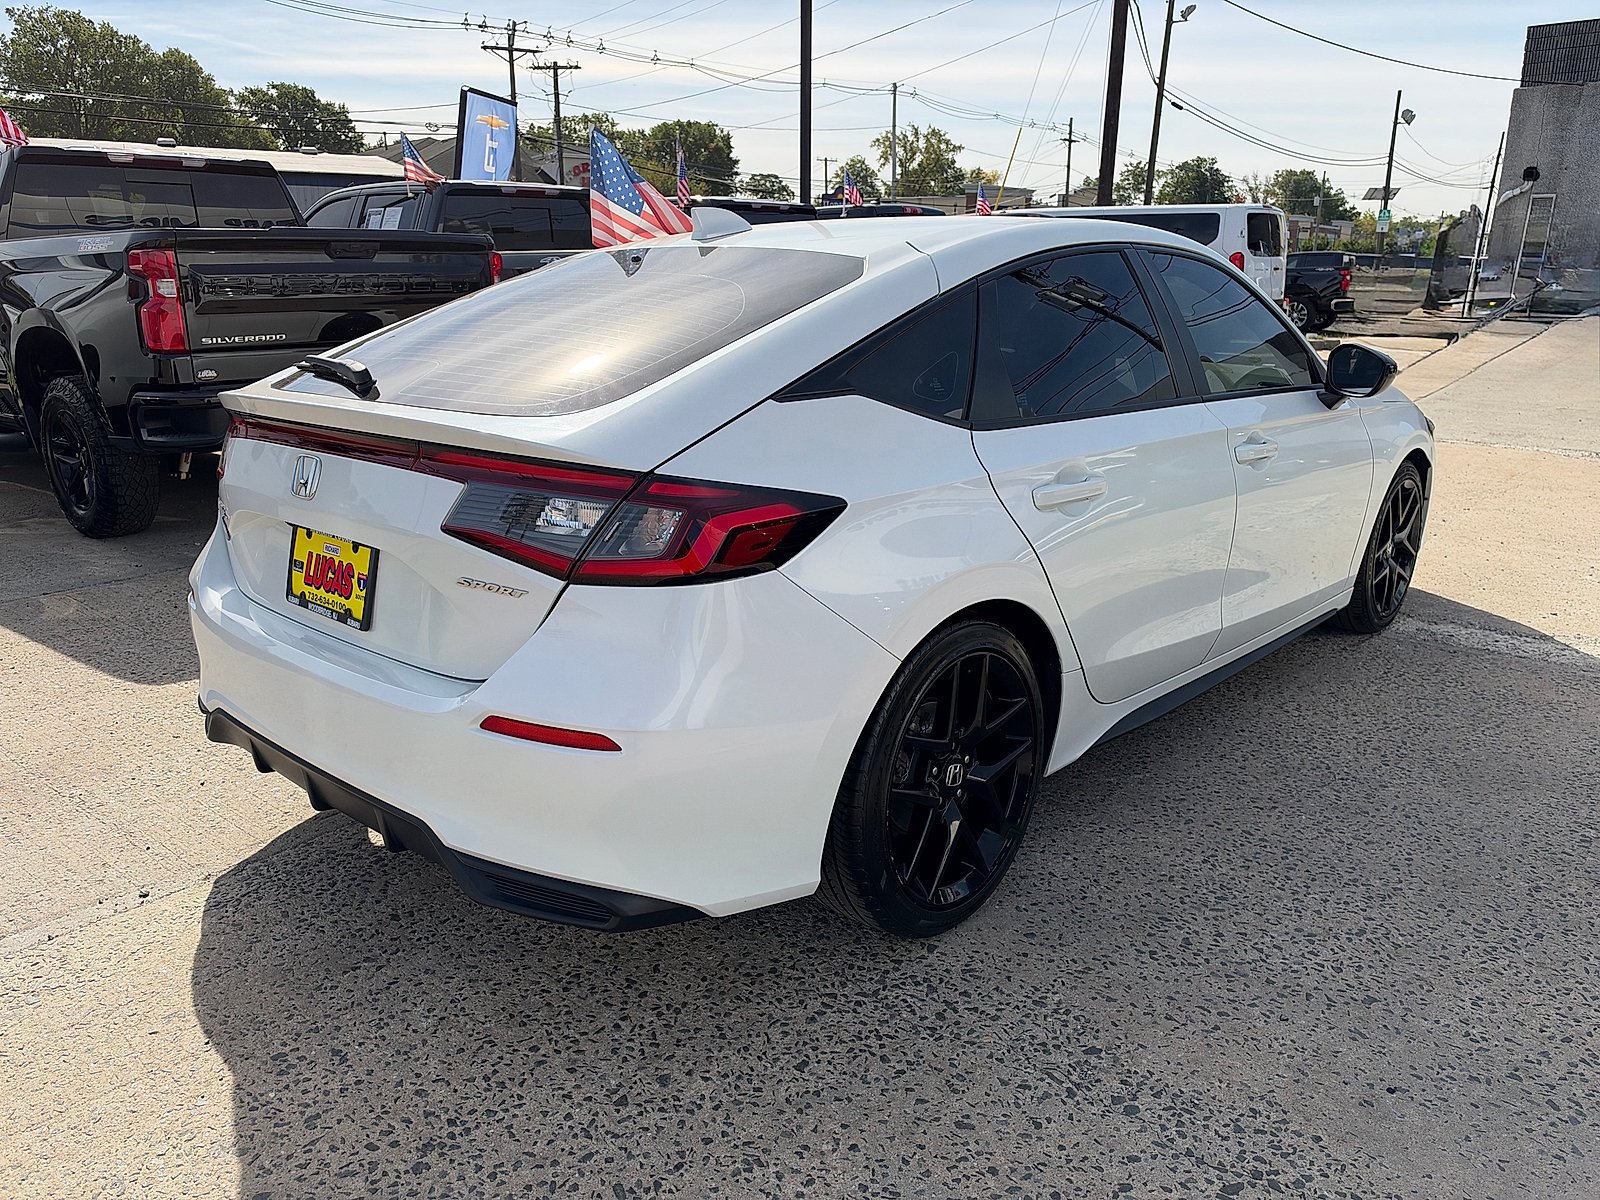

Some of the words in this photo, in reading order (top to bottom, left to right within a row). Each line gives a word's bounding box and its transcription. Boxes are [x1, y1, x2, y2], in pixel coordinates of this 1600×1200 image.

[201, 333, 287, 345] SILVERADO
[303, 550, 355, 601] LUCAS
[456, 576, 530, 599] SPORT
